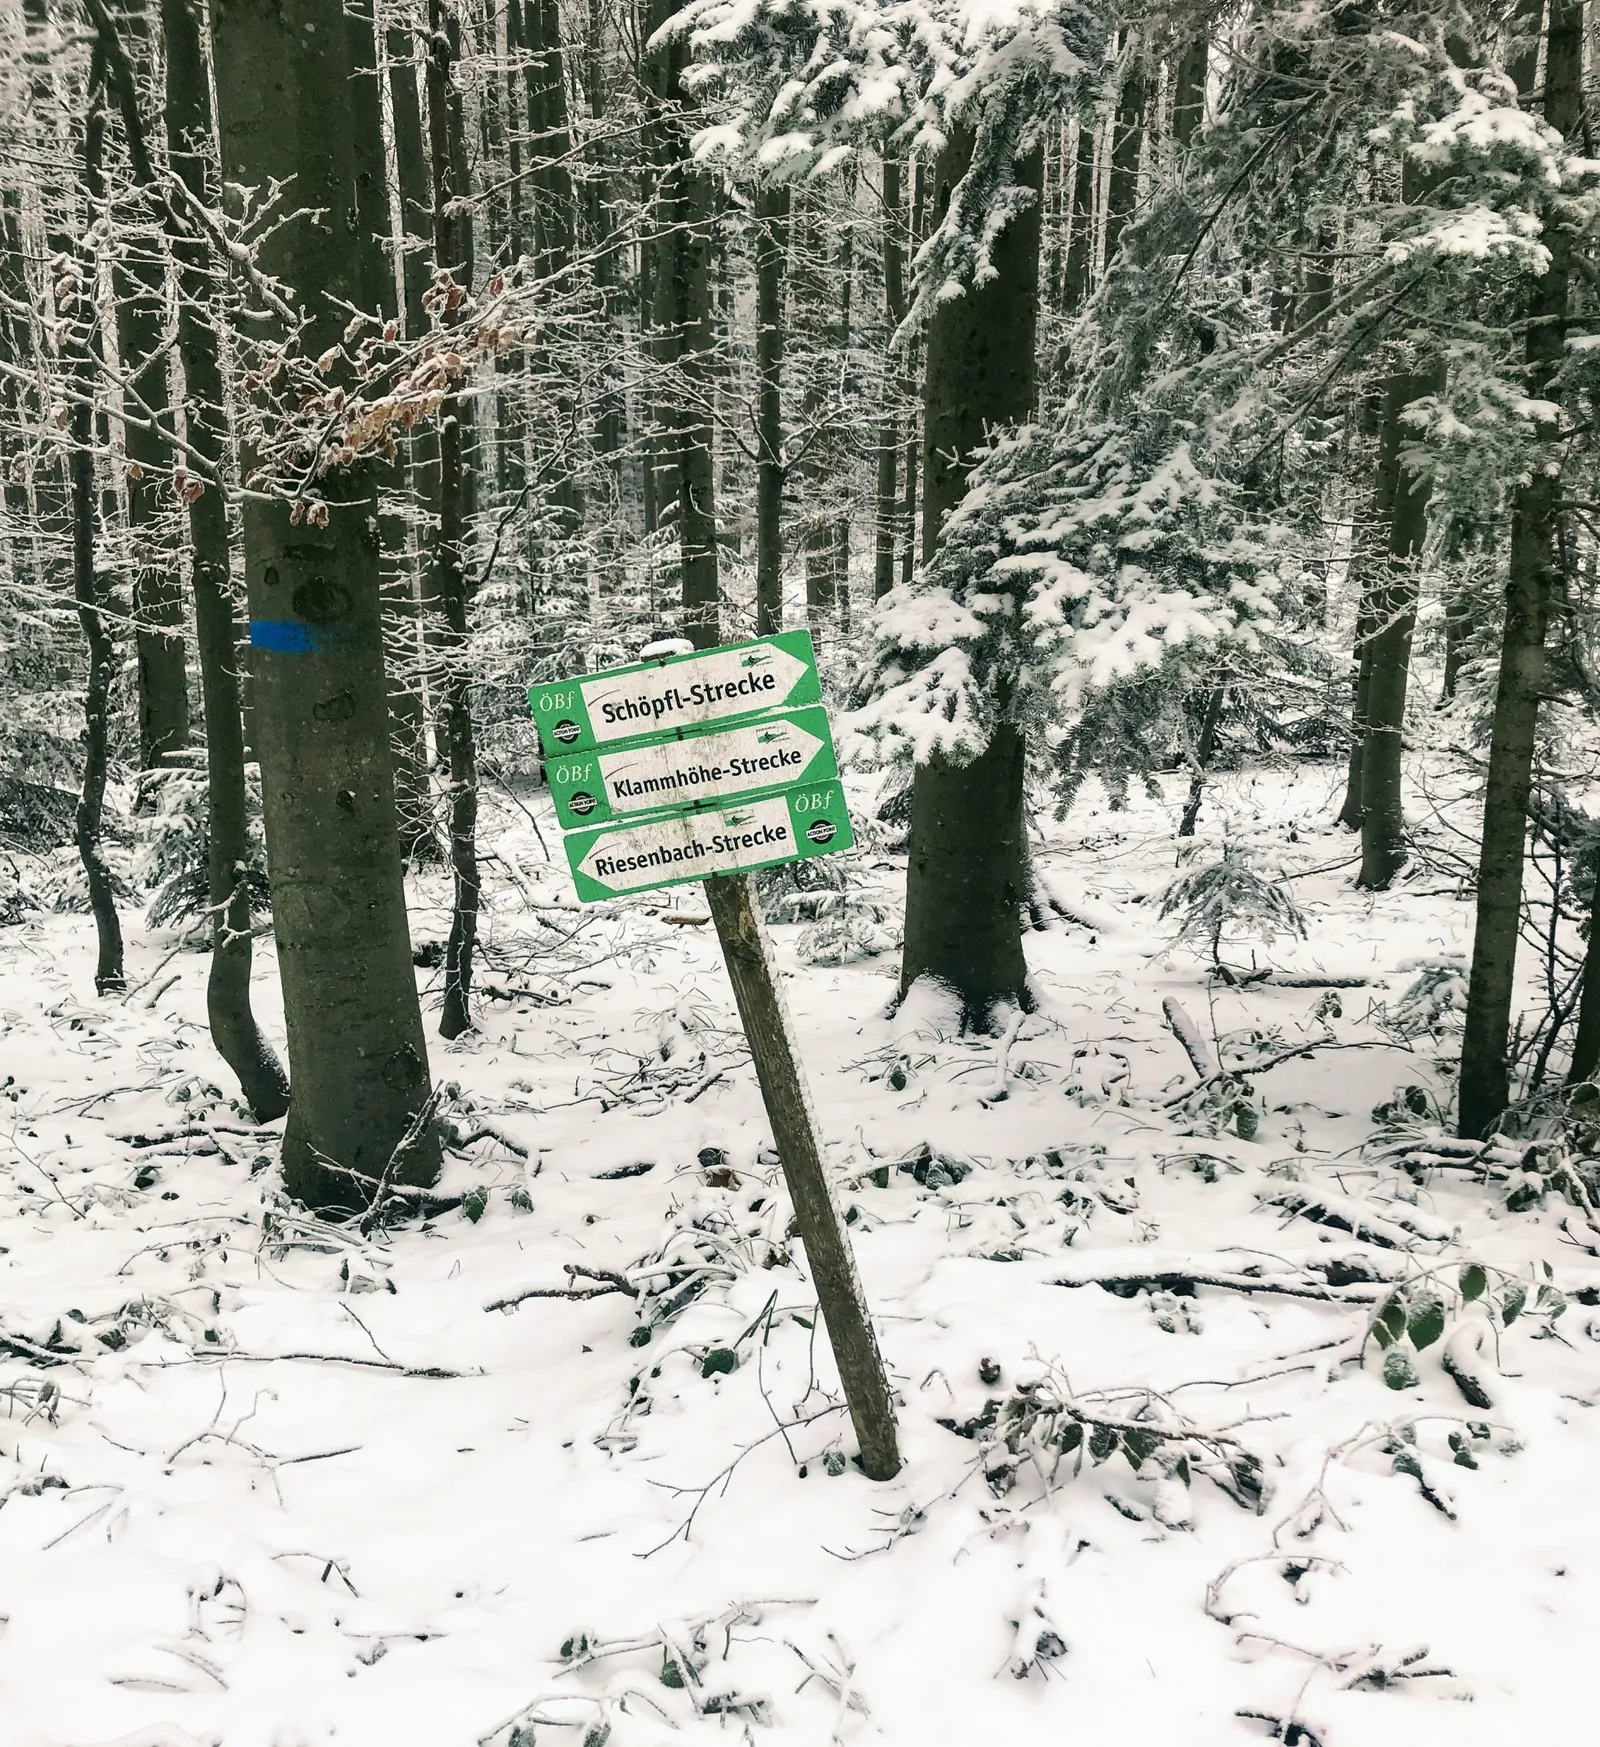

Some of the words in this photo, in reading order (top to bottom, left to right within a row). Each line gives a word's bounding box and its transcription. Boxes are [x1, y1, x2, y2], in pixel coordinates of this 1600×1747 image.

[539, 690, 575, 712] ÖBf
[602, 671, 776, 723] Schöpfl-Strecke
[556, 763, 592, 784] ÖBf
[614, 748, 802, 798] Klammhöhe-Strecke
[795, 790, 834, 812] ÖBf
[595, 825, 788, 876] Riesenbach-Strecke
